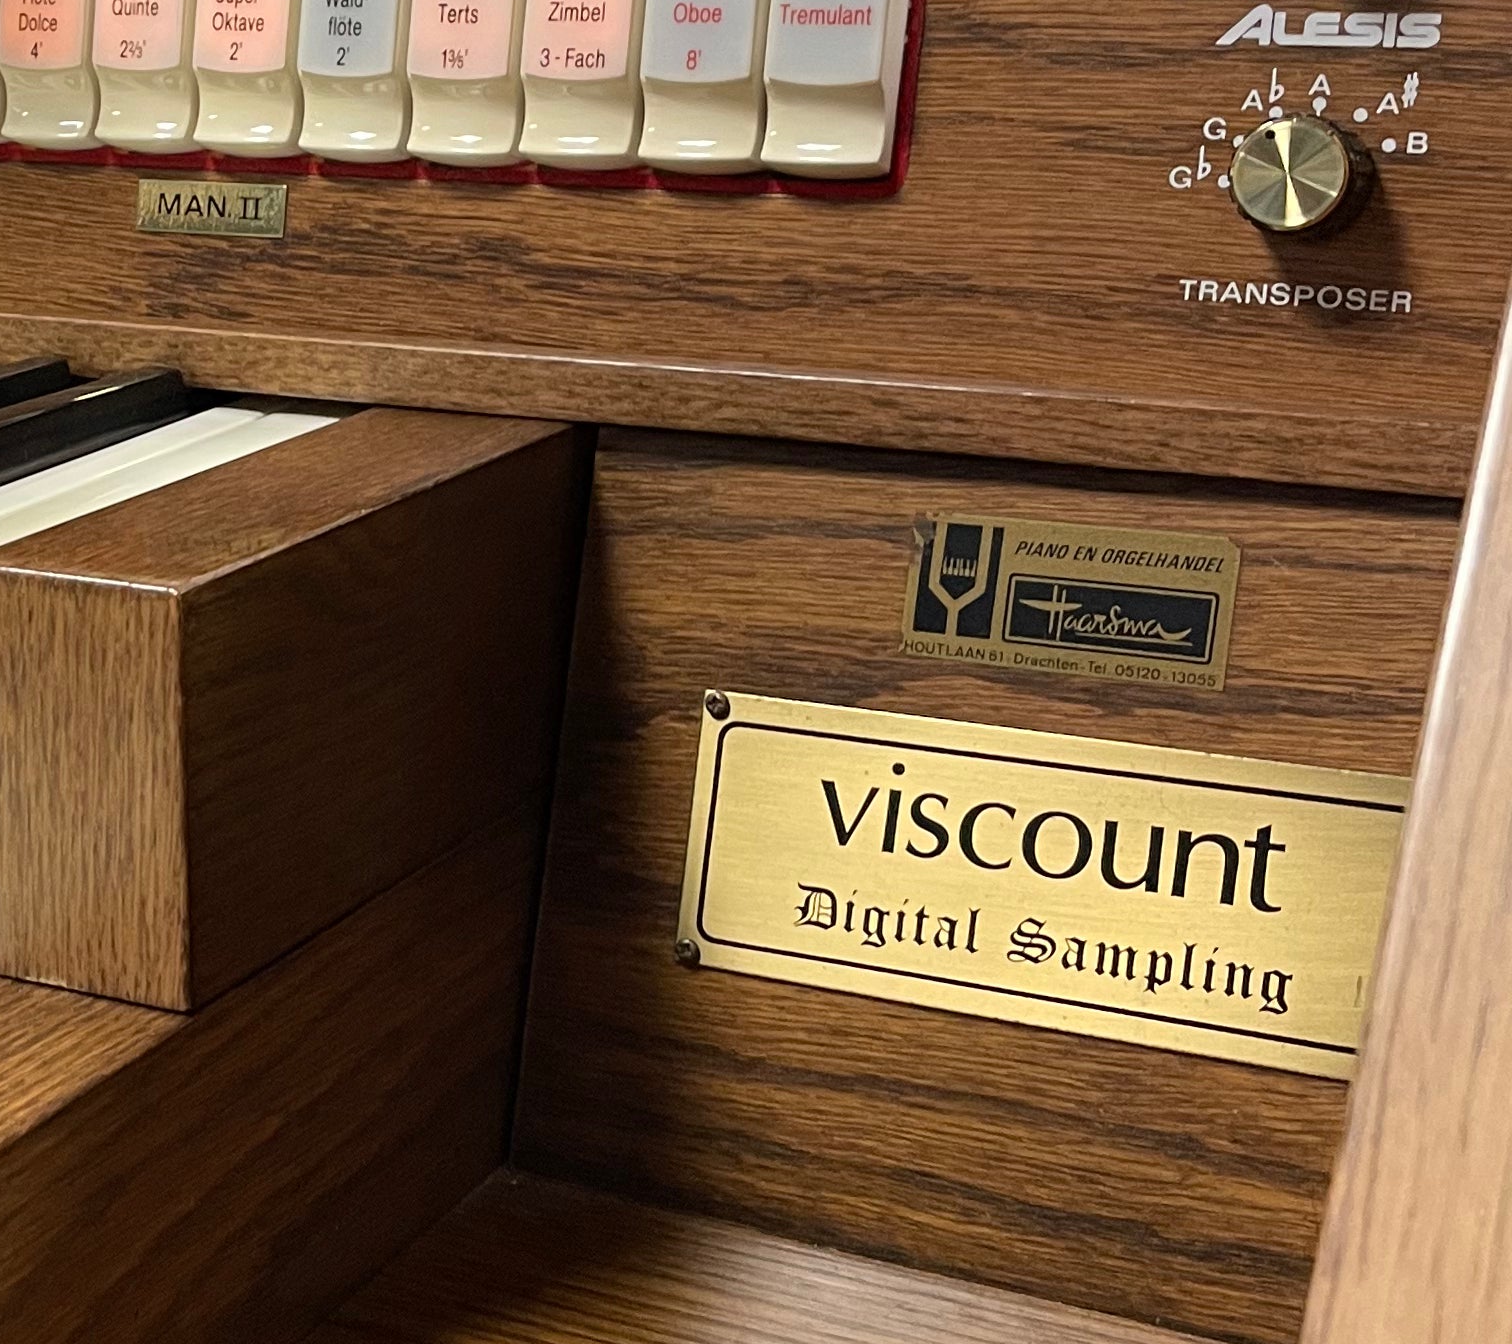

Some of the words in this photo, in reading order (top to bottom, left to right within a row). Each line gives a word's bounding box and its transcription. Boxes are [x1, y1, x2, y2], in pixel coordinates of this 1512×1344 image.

[18, 13, 58, 32] Dolce
[212, 12, 265, 33] Oktave
[438, 3, 479, 24] Terts
[548, 1, 606, 22] Zimbel
[673, 2, 722, 23] Oboe
[779, 4, 872, 26] Tremulant
[1215, 4, 1442, 49] ALESIS
[564, 48, 605, 68] Fach
[1308, 73, 1331, 96] A
[1202, 116, 1227, 140] G
[1405, 132, 1429, 154] B
[158, 193, 232, 218] MAN.
[240, 196, 263, 220] II
[1179, 279, 1413, 313] TRANSPOSER
[1014, 540, 1069, 560] PIANO
[1073, 545, 1096, 562] EN
[1102, 549, 1226, 573] ORGELHANDEL
[820, 763, 1287, 914] viscount
[795, 881, 981, 954] Digital
[1006, 917, 1294, 1014] Sampling
